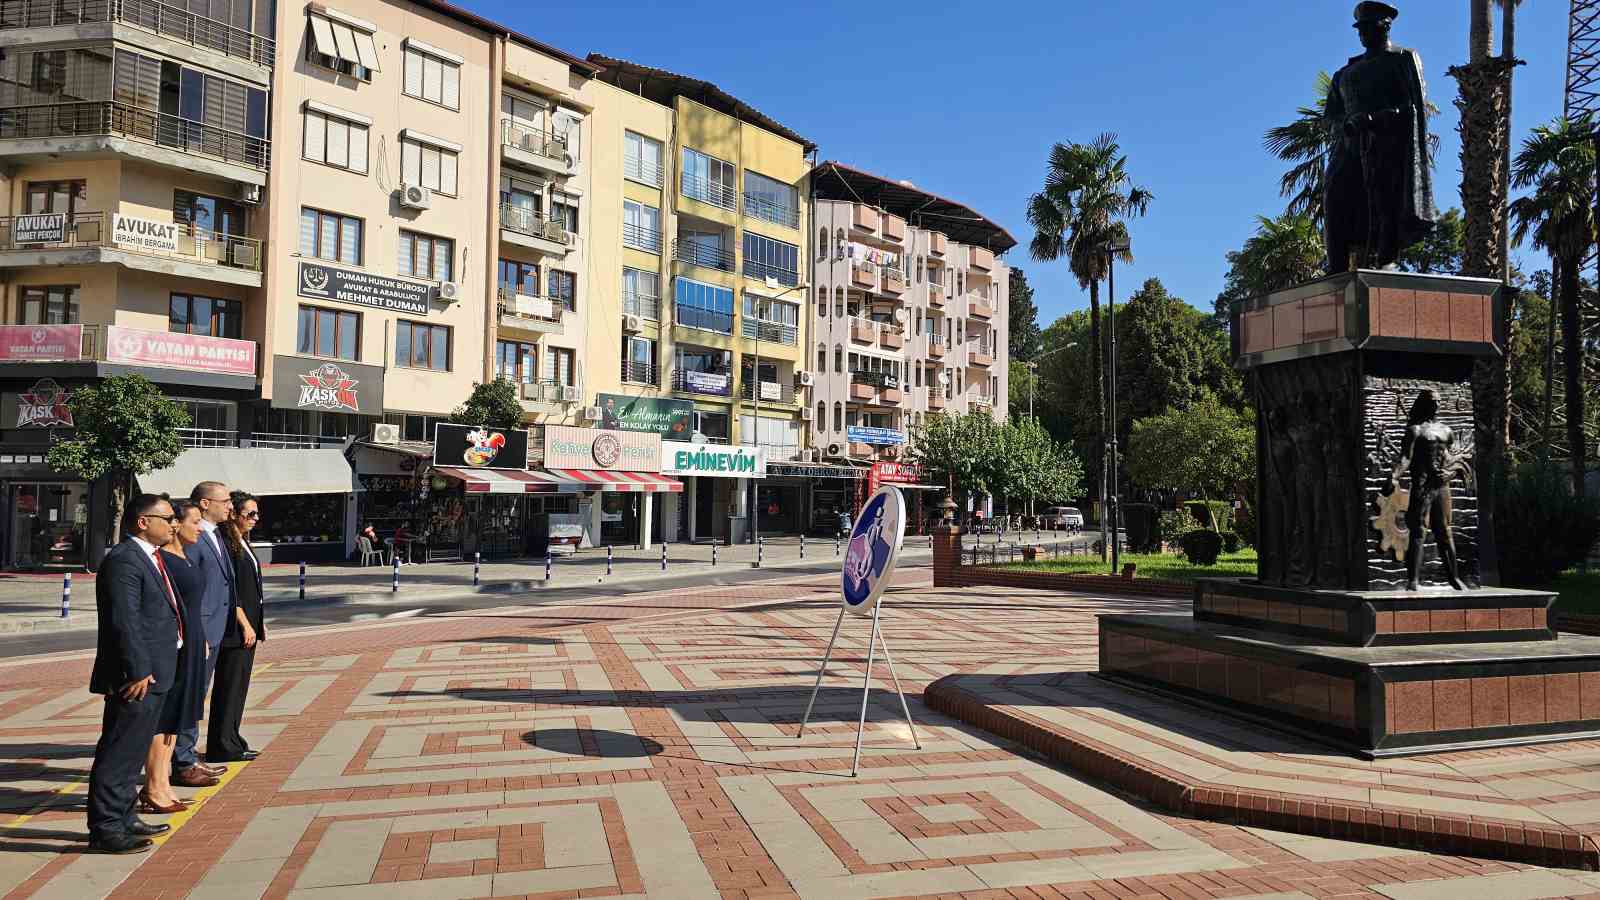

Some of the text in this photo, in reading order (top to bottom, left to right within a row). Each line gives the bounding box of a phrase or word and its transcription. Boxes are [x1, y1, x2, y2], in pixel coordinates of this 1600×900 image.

[17, 215, 62, 231] AVUKAT
[117, 216, 175, 239] AVUKAT
[144, 238, 176, 250] BERGAMA
[336, 271, 427, 294] DUMAN HUKUK BÜROSU
[343, 282, 372, 294] AVUKAT
[379, 288, 420, 301] ARABULUCU
[336, 290, 426, 313] MEHMET DUMAN
[147, 340, 195, 359] VATAN
[620, 421, 670, 432] EN KOLAY YOLU
[674, 446, 756, 473] EMİNEVİM
